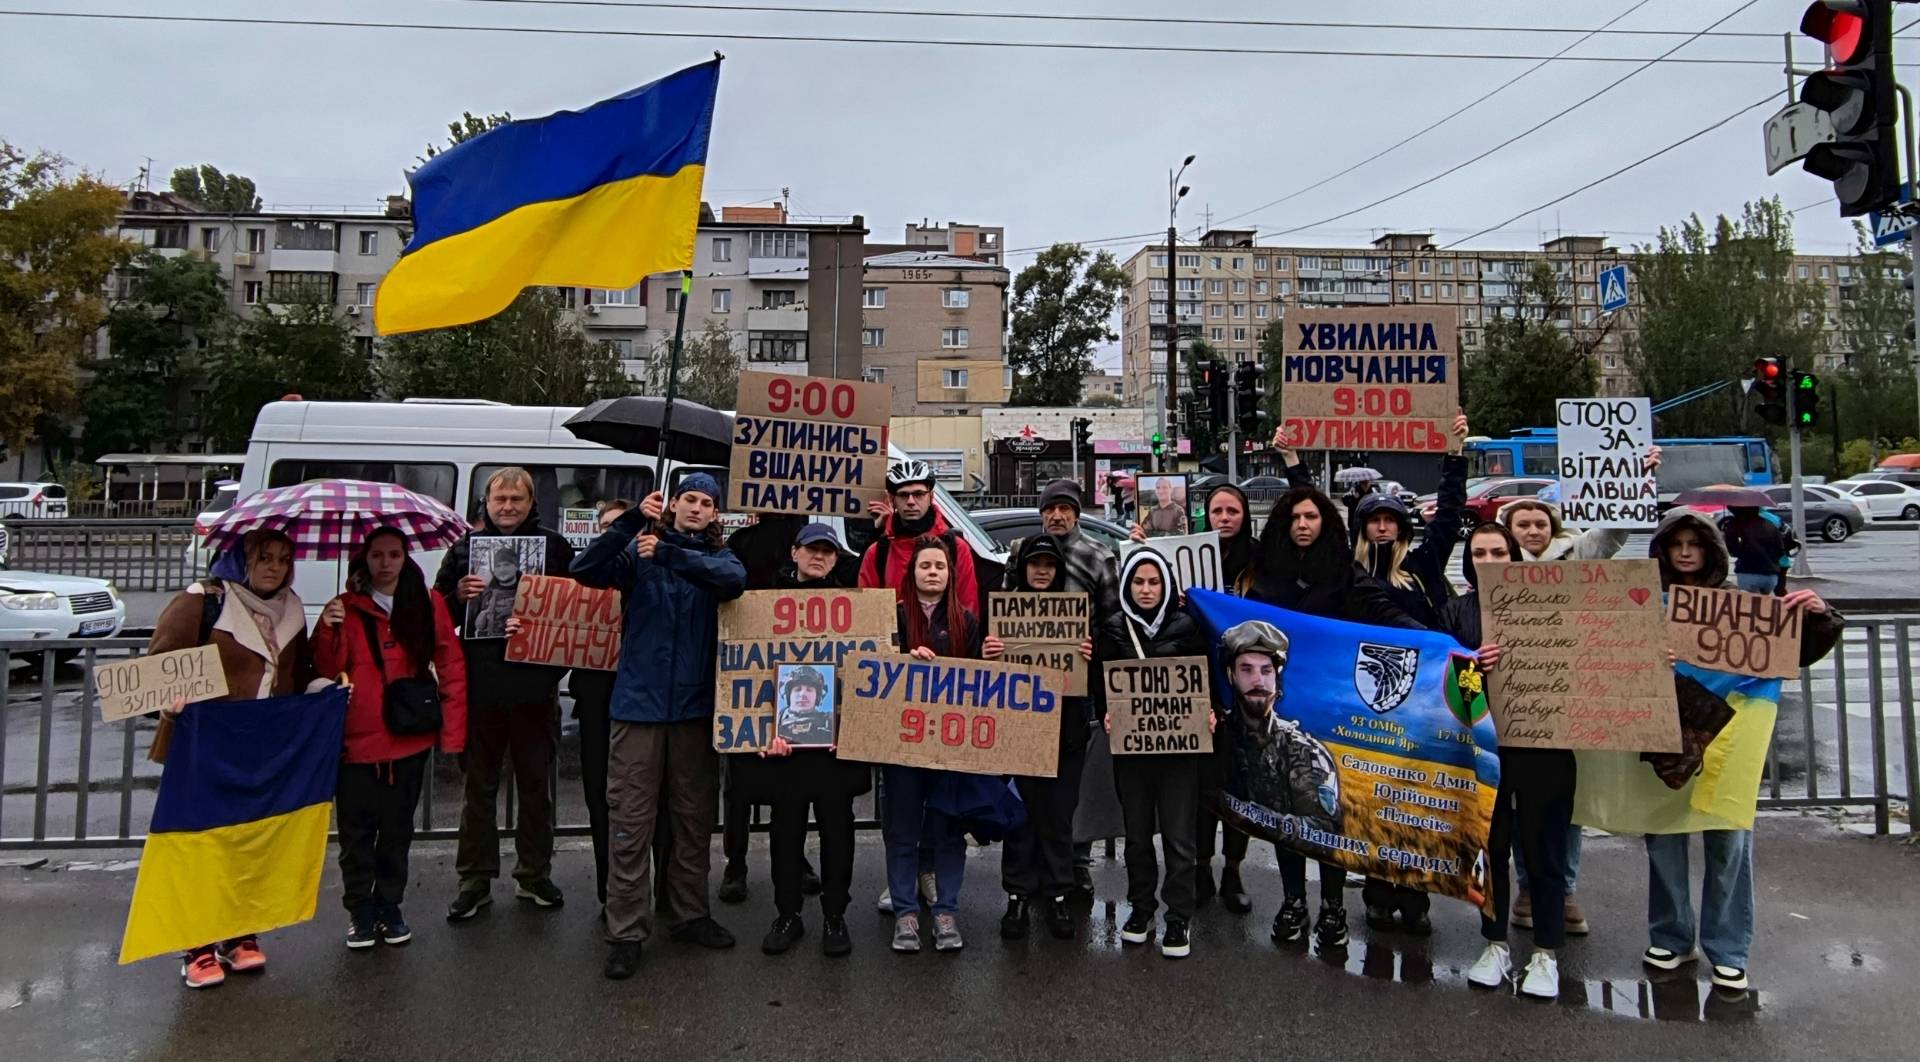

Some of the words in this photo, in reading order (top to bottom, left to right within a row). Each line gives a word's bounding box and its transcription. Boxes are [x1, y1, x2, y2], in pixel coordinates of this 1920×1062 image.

[1298, 323, 1438, 350] ХВИЛИНА
[1285, 355, 1446, 384] МОВЧАННЯ
[768, 378, 855, 418] 9:00
[1333, 388, 1412, 416] 9:00
[1558, 401, 1637, 427] СТОЮ
[734, 417, 888, 456] ЗУПИНИСЬ!
[1285, 419, 1447, 449] ЗУПИНИСЬ
[748, 450, 863, 485] ВШАНУЙ
[740, 482, 861, 514] ПАМ'ЯТЬ
[1561, 502, 1658, 522] НАСЛЕДОВ
[1503, 564, 1563, 584] СТОЮ
[992, 594, 1087, 617] ПАМ'ЯТАТИ
[1490, 585, 1571, 608] Сувалко
[772, 596, 853, 634] 9:00
[998, 621, 1086, 638] ШАНУВАТИ
[855, 659, 1055, 713] ЗУПИНИСЬ
[1108, 666, 1169, 694] СТОЮ
[1175, 665, 1202, 694] ЗА
[121, 679, 215, 715] ЗУПИНИСЬ
[1131, 697, 1192, 716] РОМАН
[900, 708, 996, 749] 9:00
[1123, 734, 1199, 752] СУВАЛКО
[1342, 754, 1427, 782] Садовенко
[1373, 783, 1459, 812] Юрійович
[1376, 807, 1452, 832] «Плюсік»
[1300, 823, 1369, 855] наших
[1377, 846, 1461, 876] серцях!
